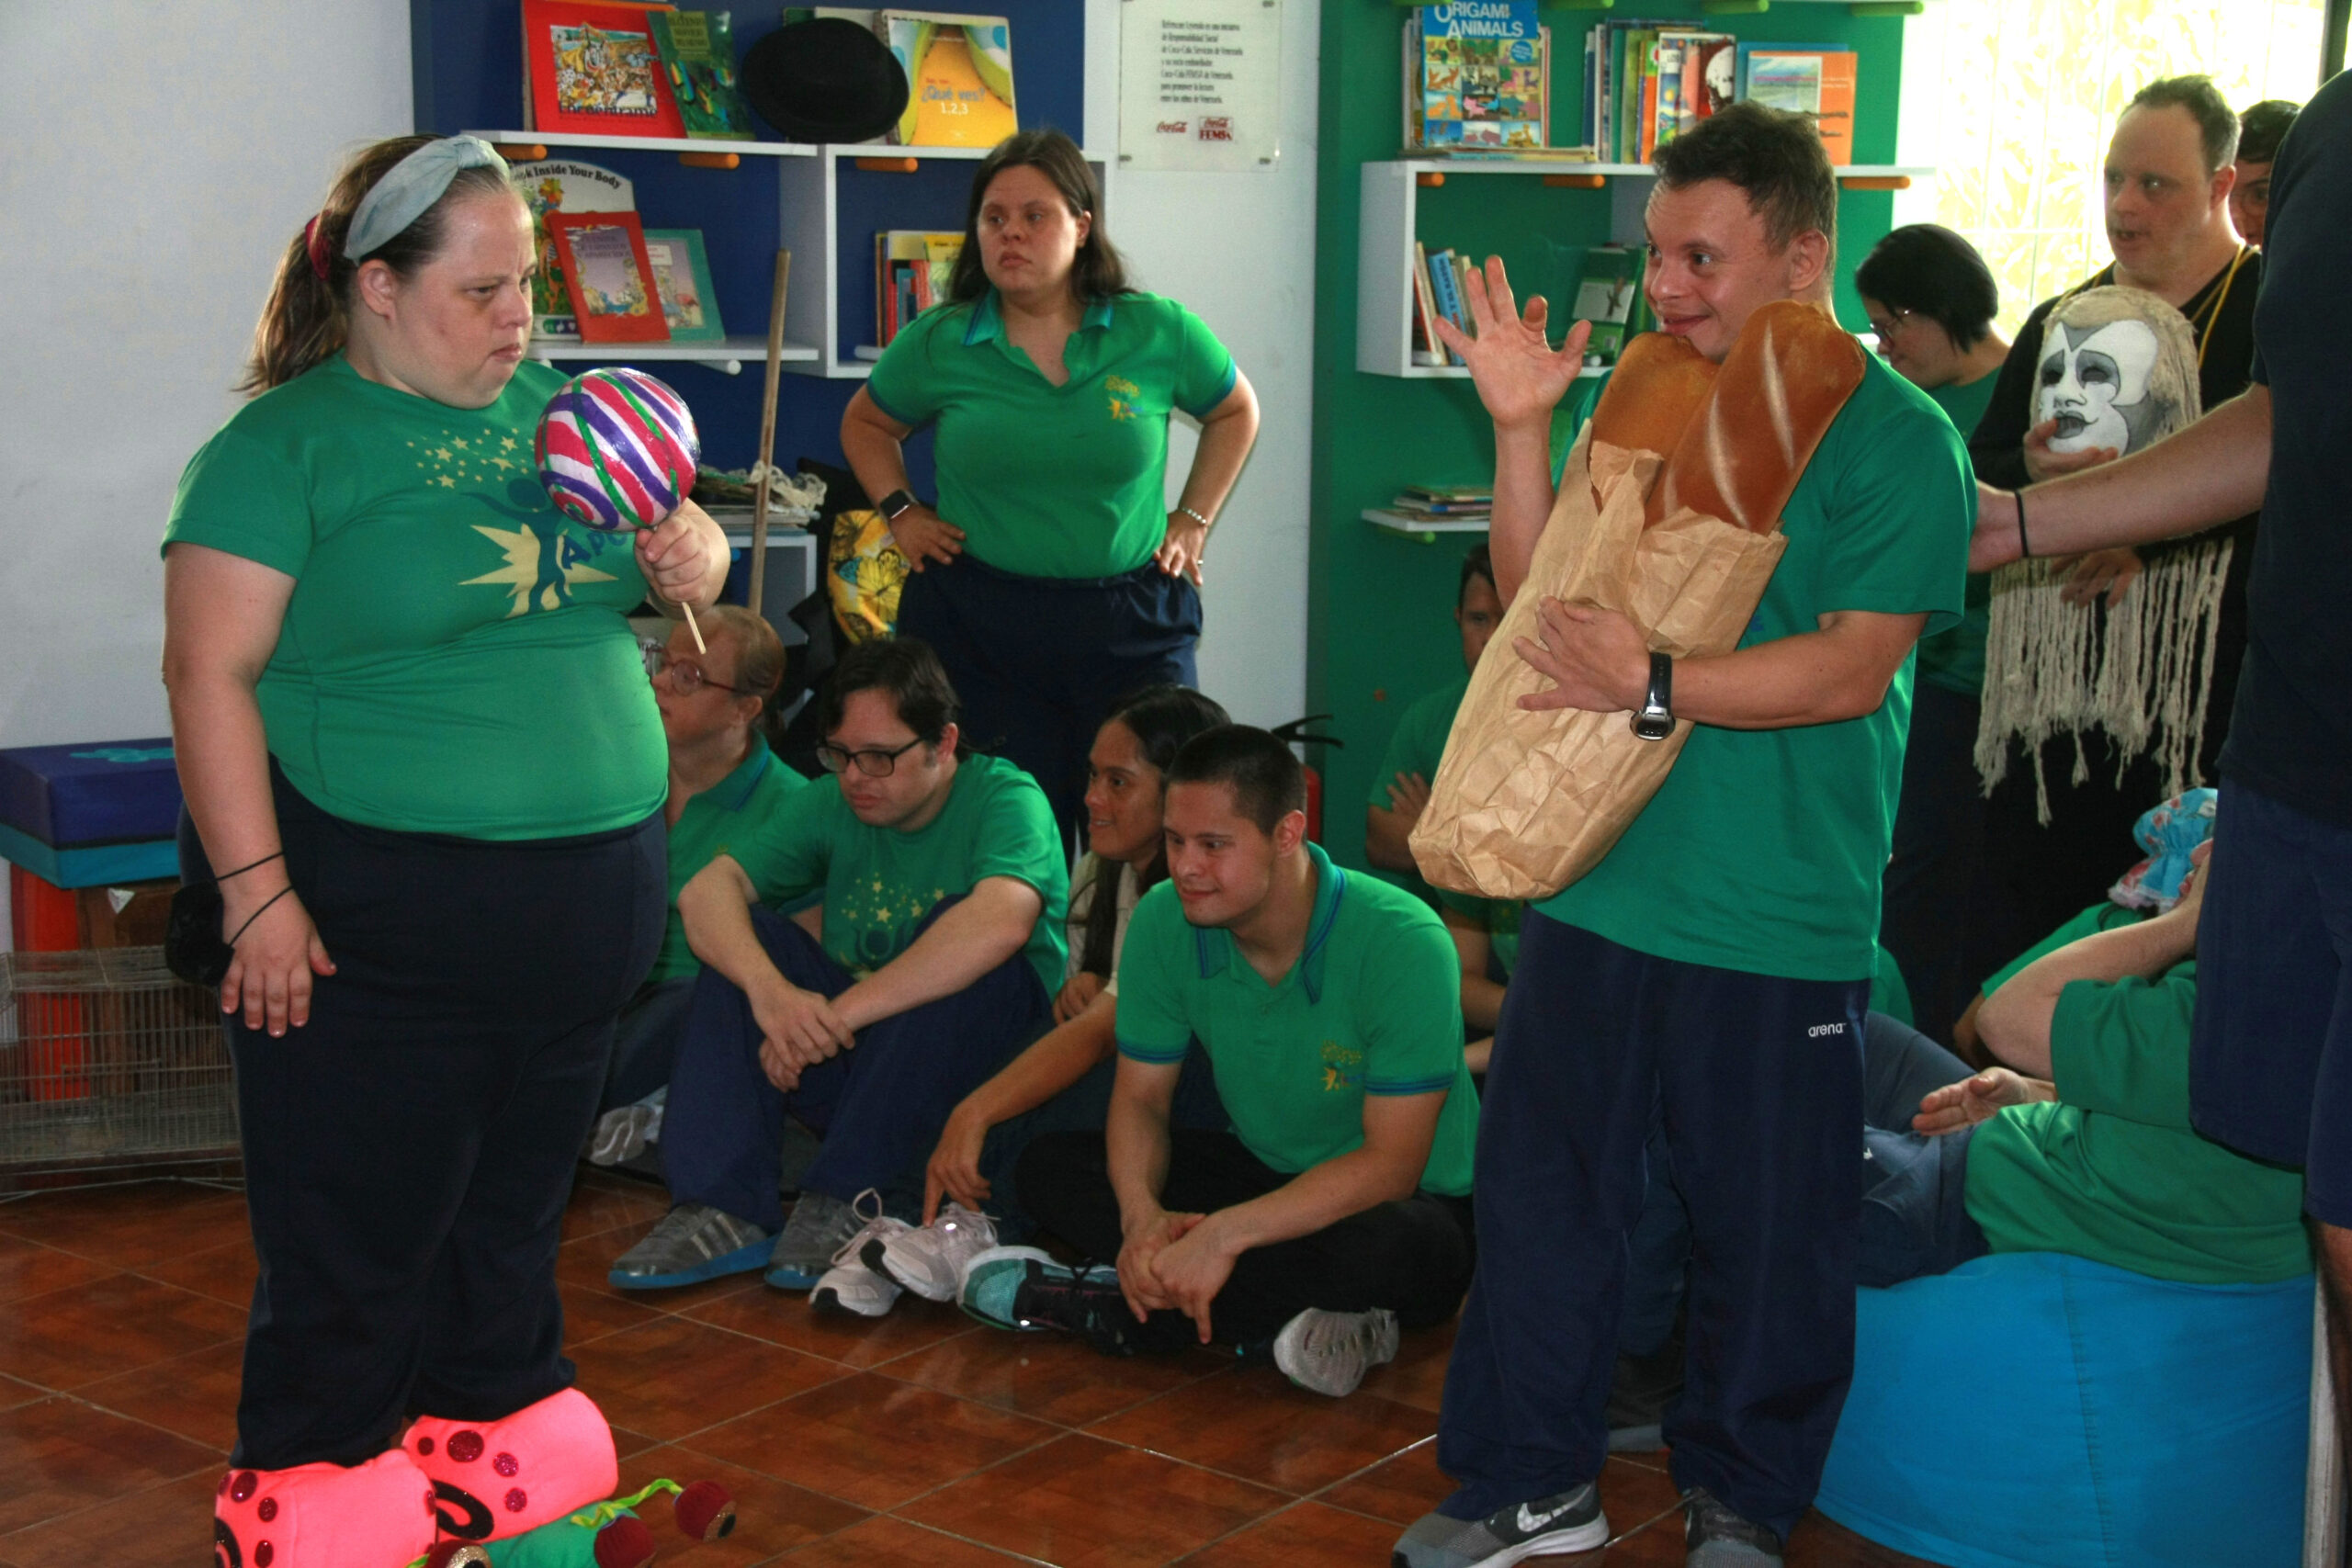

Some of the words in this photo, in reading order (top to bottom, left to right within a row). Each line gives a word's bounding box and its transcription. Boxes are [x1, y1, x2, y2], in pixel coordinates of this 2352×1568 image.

[1434, 1, 1510, 23] ORIGAMI
[1446, 19, 1524, 39] ANIMALS
[533, 164, 567, 176] Inside
[569, 164, 594, 179] Your
[595, 170, 622, 189] Body
[1808, 1023, 1844, 1038] arena
